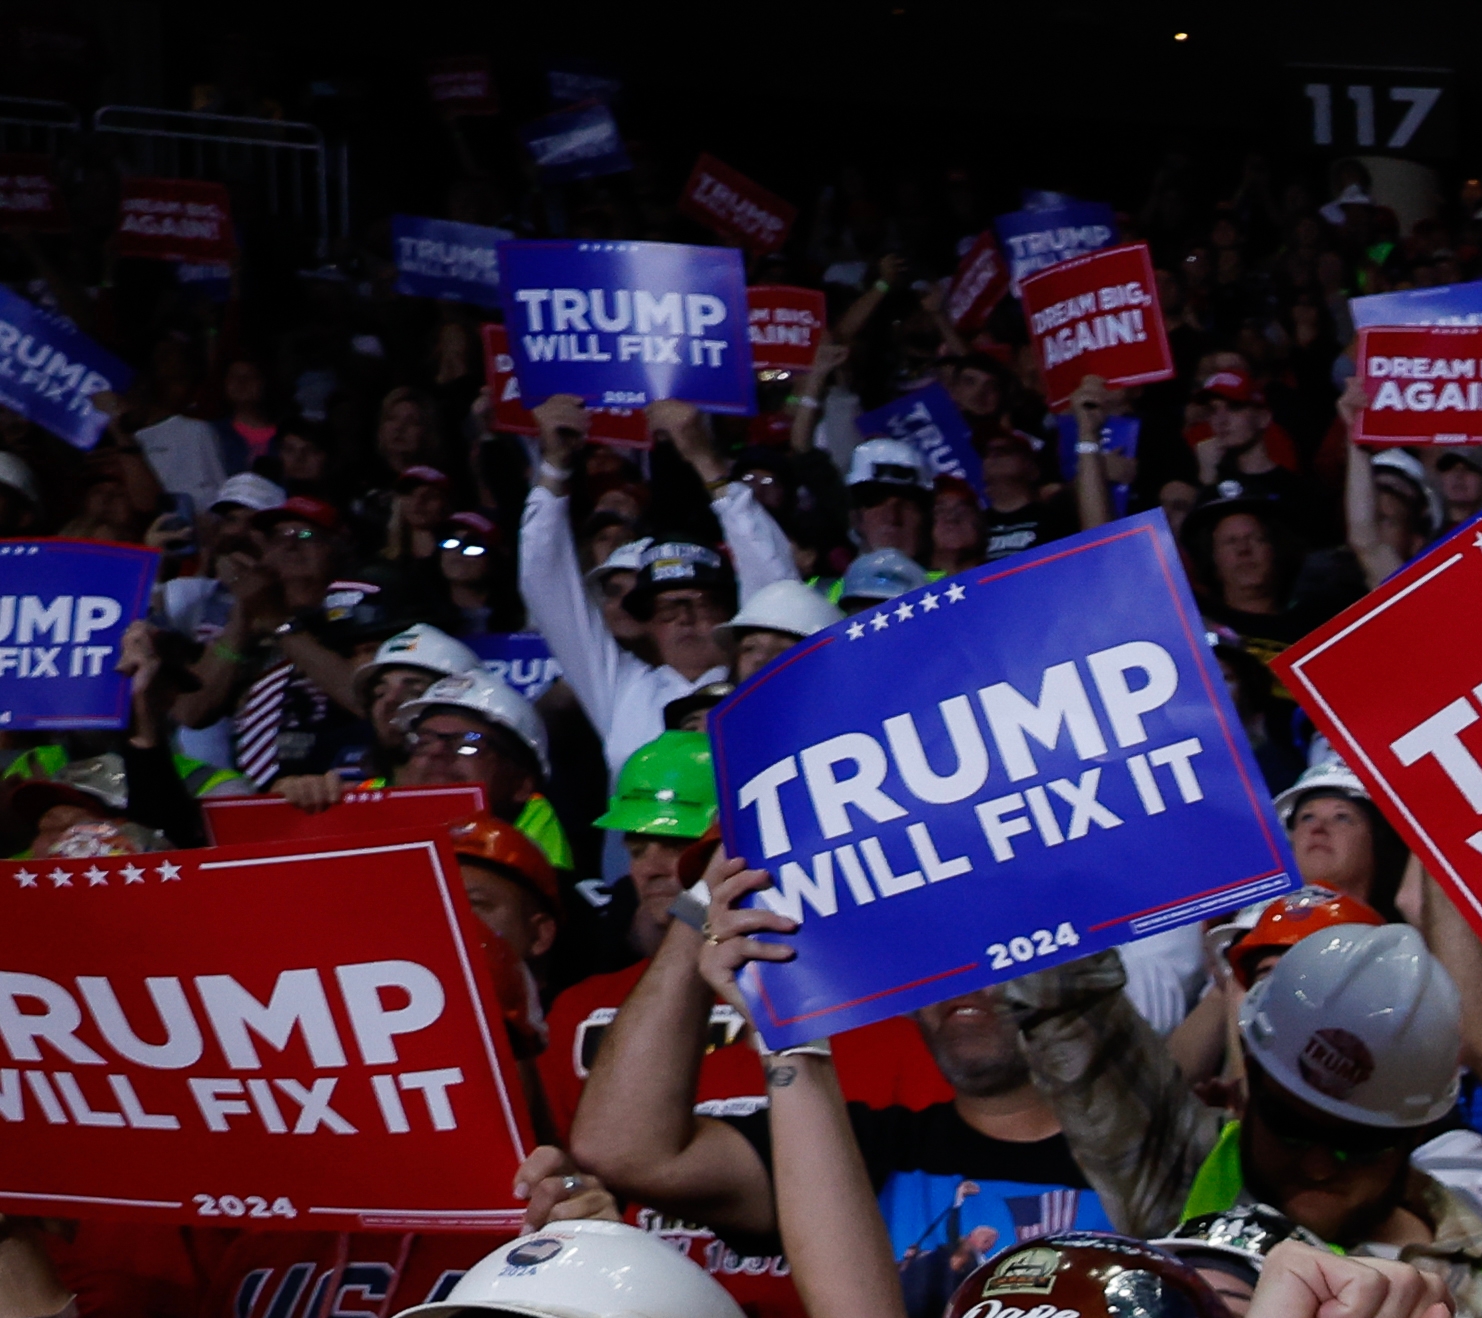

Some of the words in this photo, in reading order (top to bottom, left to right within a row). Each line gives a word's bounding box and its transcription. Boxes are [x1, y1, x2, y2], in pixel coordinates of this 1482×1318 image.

[1305, 83, 1442, 147] 117
[515, 287, 727, 336] TRUMP
[1031, 290, 1097, 335] DREAM
[1099, 280, 1152, 311] BIG,
[523, 334, 612, 363] WILL
[617, 336, 682, 365] FIX
[690, 339, 728, 369] IT
[1043, 310, 1148, 370] AGAIN!
[1366, 356, 1476, 382] DREAM
[67, 645, 112, 678] IT
[736, 639, 1179, 859] TRUMP
[760, 821, 974, 925] WILL
[973, 766, 1125, 864] FIX
[1124, 736, 1205, 816] IT
[986, 921, 1081, 971] 2024
[189, 1077, 358, 1137] FIX
[370, 1067, 465, 1134] IT
[191, 1193, 298, 1220] 2024
